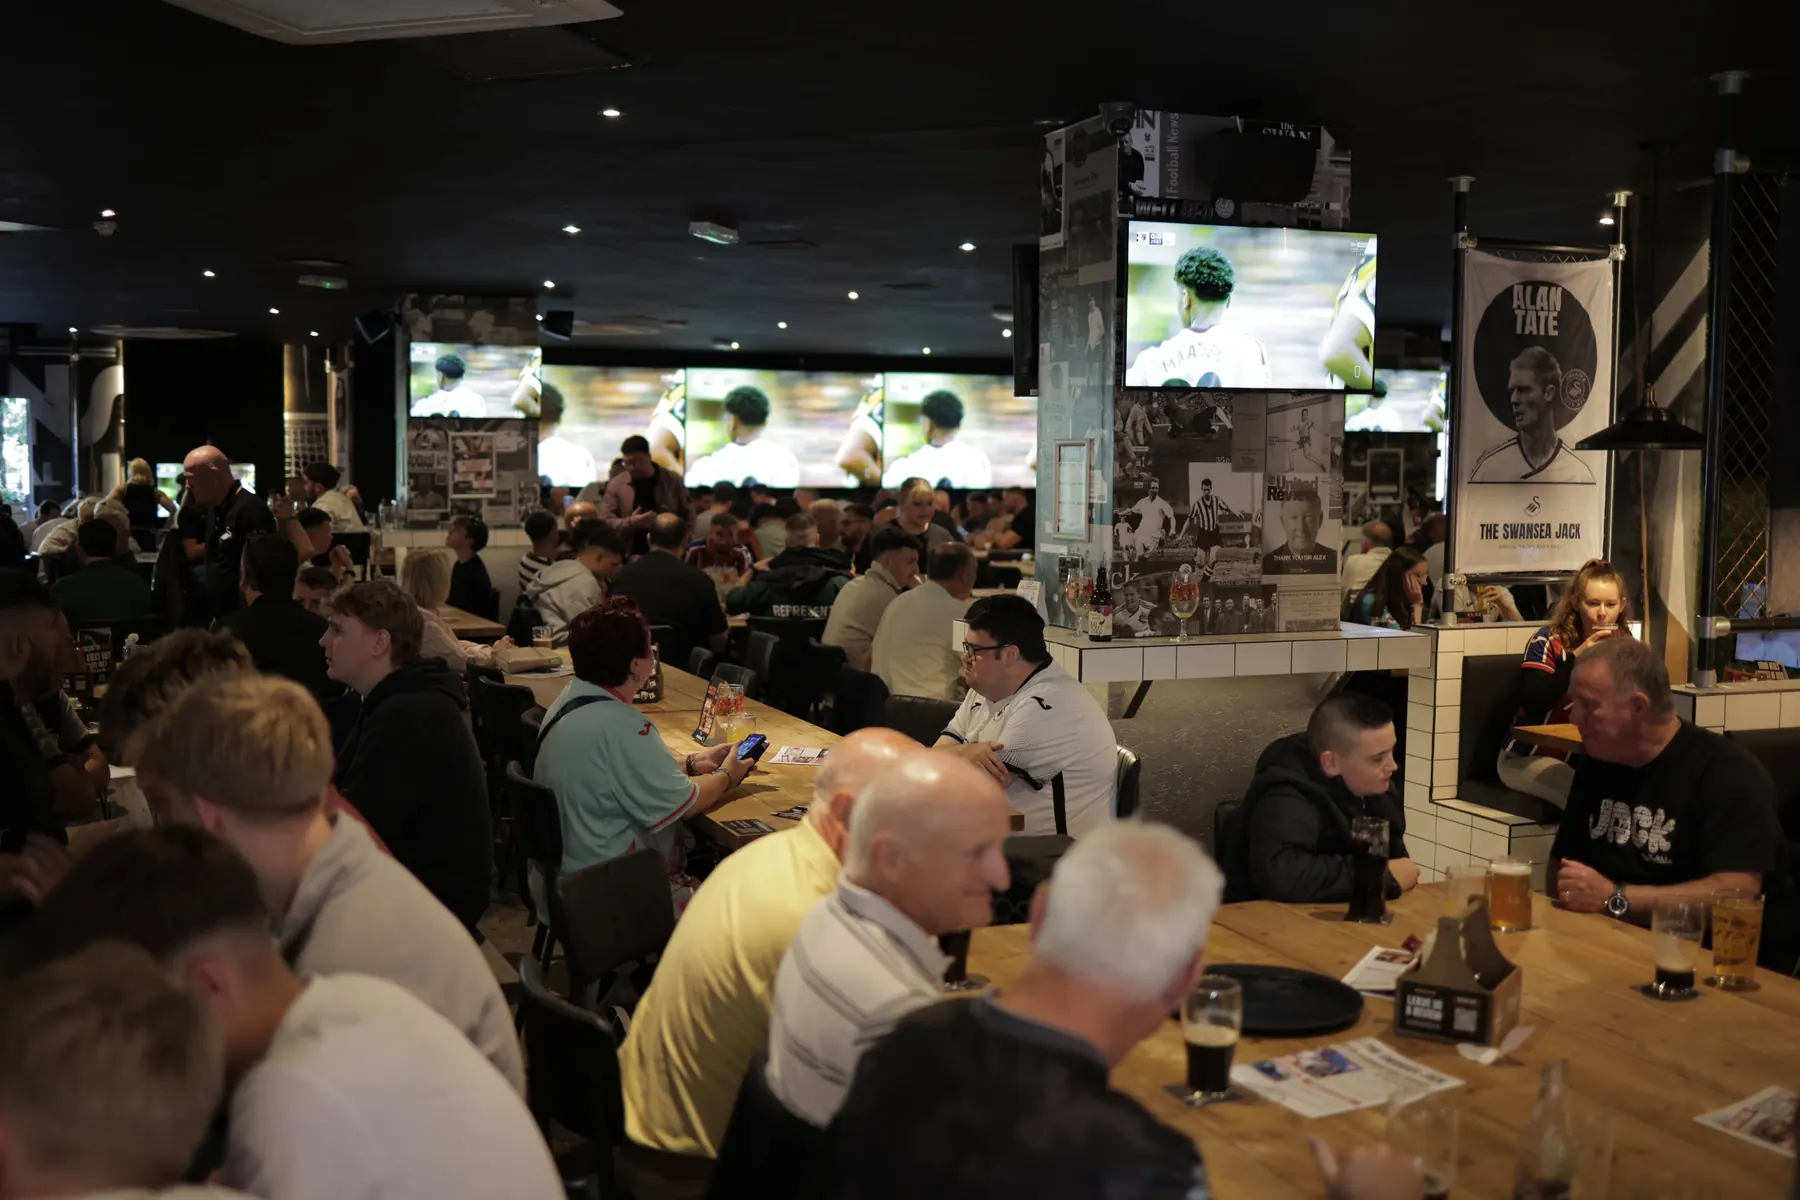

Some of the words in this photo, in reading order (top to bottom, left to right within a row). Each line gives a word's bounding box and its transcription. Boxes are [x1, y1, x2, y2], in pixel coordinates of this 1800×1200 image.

[1166, 111, 1179, 142] News
[1280, 121, 1295, 130] the
[1165, 146, 1179, 194] Football
[1512, 284, 1562, 312] ALAN
[1514, 309, 1559, 337] TATE
[1276, 475, 1319, 491] United
[1480, 523, 1499, 540] THE
[1502, 523, 1552, 540] SWANSEA
[1555, 523, 1581, 540] JACK
[1273, 554, 1291, 562] THANK
[1292, 554, 1303, 562] YOU
[1588, 798, 1677, 854] JACK
